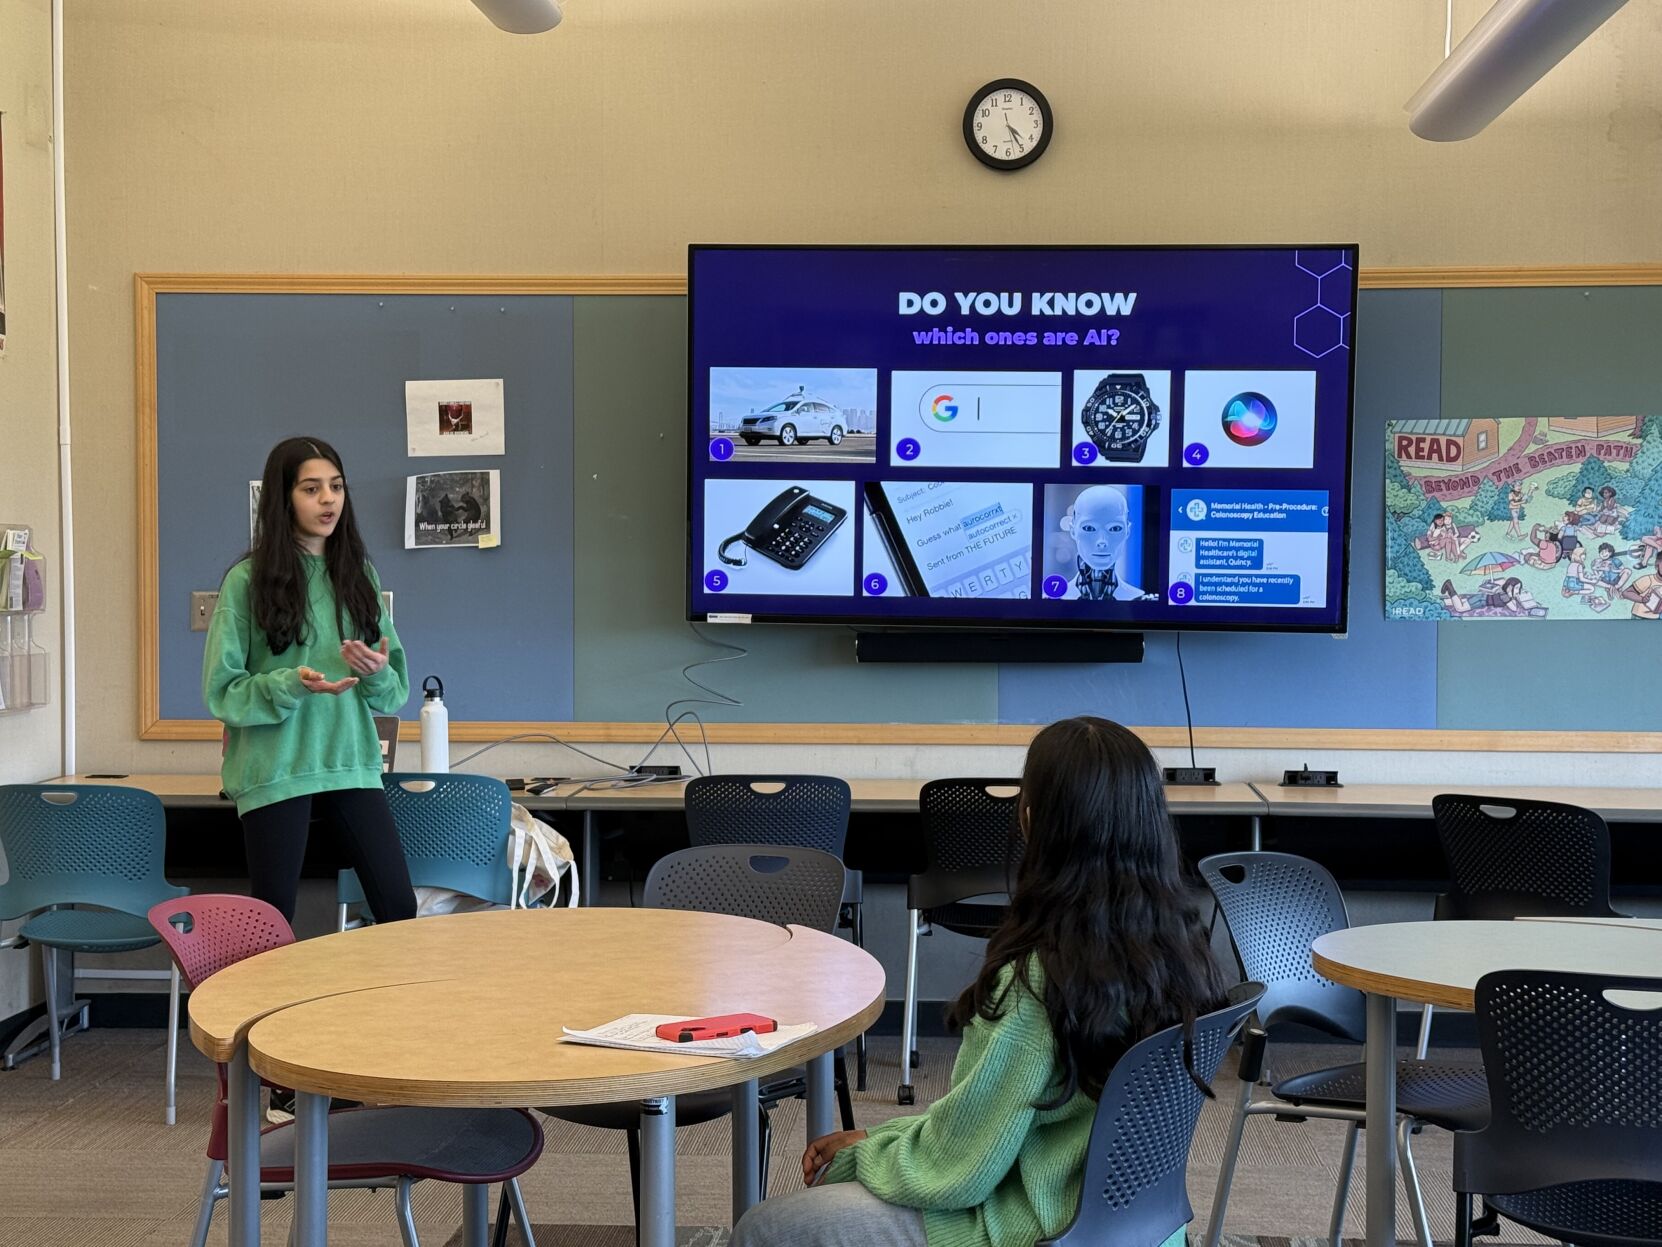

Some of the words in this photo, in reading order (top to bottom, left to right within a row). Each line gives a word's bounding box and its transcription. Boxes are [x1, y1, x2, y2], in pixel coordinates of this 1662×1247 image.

[990, 98, 998, 107] 11
[1003, 94, 1012, 103] 12
[1020, 97, 1024, 106] 1
[981, 108, 990, 118] 10
[1028, 106, 1035, 116] 2
[976, 122, 983, 131] 9
[1033, 120, 1039, 129] 3
[982, 135, 988, 144] 8
[1028, 134, 1034, 143] 4
[992, 145, 998, 154] 7
[1005, 148, 1011, 157] 6
[1019, 144, 1025, 153] 5
[899, 292, 947, 316] DO
[954, 292, 1022, 316] YOU
[1031, 292, 1137, 316] KNOW
[912, 326, 979, 345] which
[984, 330, 1037, 346] ones
[1043, 331, 1079, 346] are
[1083, 329, 1120, 346] AI?
[931, 395, 959, 423] G
[719, 444, 725, 455] 1
[905, 444, 914, 456] 2
[1081, 447, 1090, 459] 3
[1396, 435, 1462, 463] READ
[1192, 449, 1202, 460] 4
[1424, 475, 1481, 495] BEYOND
[1492, 463, 1522, 482] THE
[1528, 445, 1587, 469] BEATEN
[1595, 443, 1634, 459] PATH
[1211, 502, 1241, 510] Memorial
[1268, 503, 1318, 511] Pre-Procedure:
[906, 513, 922, 524] Hey
[1211, 511, 1253, 520] Colonoscopy
[1254, 511, 1286, 519] Education
[419, 521, 436, 531] When
[436, 523, 450, 533] your
[451, 521, 467, 530] circle
[968, 516, 1012, 540] autocorrect
[917, 533, 942, 547] Guess
[943, 523, 962, 537] what
[927, 558, 946, 571] Sent
[946, 550, 965, 562] from
[965, 541, 983, 554] THE
[983, 526, 1017, 546] FUTURE
[1200, 540, 1218, 548] Hello!
[1219, 540, 1228, 548] I'm
[1229, 540, 1259, 548] Memorial
[1200, 549, 1236, 557] Healthcare's
[1237, 549, 1257, 558] digital
[1228, 559, 1252, 567] Quincy.
[713, 575, 721, 587] 5
[951, 587, 963, 597] W
[968, 581, 977, 592] E
[984, 575, 994, 587] R
[1000, 567, 1007, 578] T
[1014, 561, 1023, 572] Y
[1252, 576, 1268, 584] have
[1268, 577, 1294, 585] recently
[871, 579, 879, 590] 6
[1051, 581, 1059, 592] 7
[1200, 584, 1216, 592] been
[1216, 585, 1248, 593] scheduled
[1249, 585, 1258, 593] for
[1176, 588, 1186, 599] 8
[1199, 594, 1240, 602] colonoscopy.
